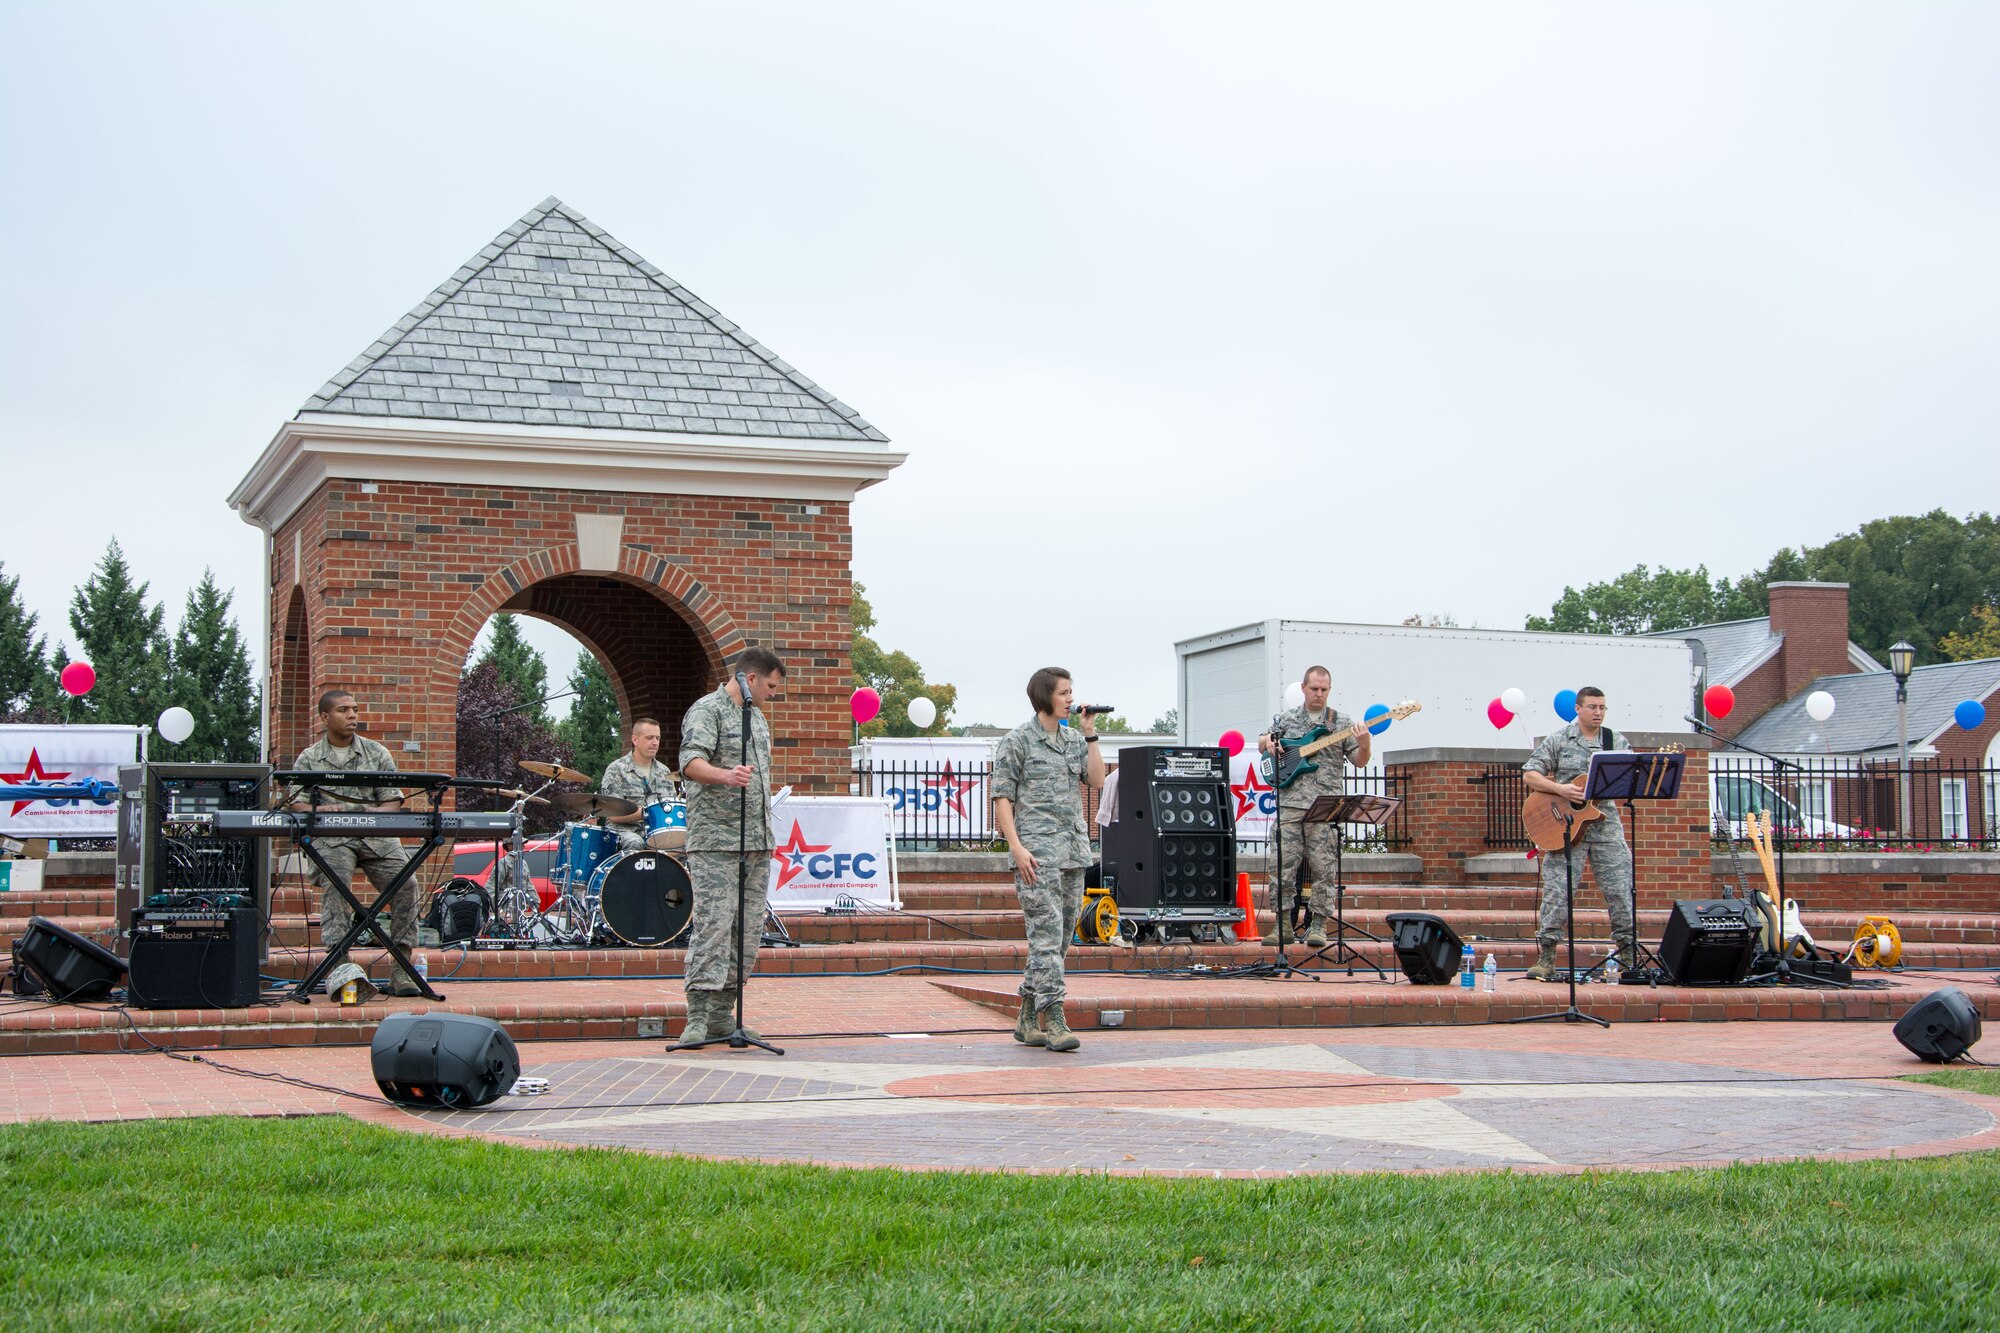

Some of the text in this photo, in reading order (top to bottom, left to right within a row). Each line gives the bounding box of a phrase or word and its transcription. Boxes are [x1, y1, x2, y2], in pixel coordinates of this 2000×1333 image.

[251, 815, 283, 826] KORG
[807, 852, 877, 880] CFC
[160, 931, 193, 940] Roland
